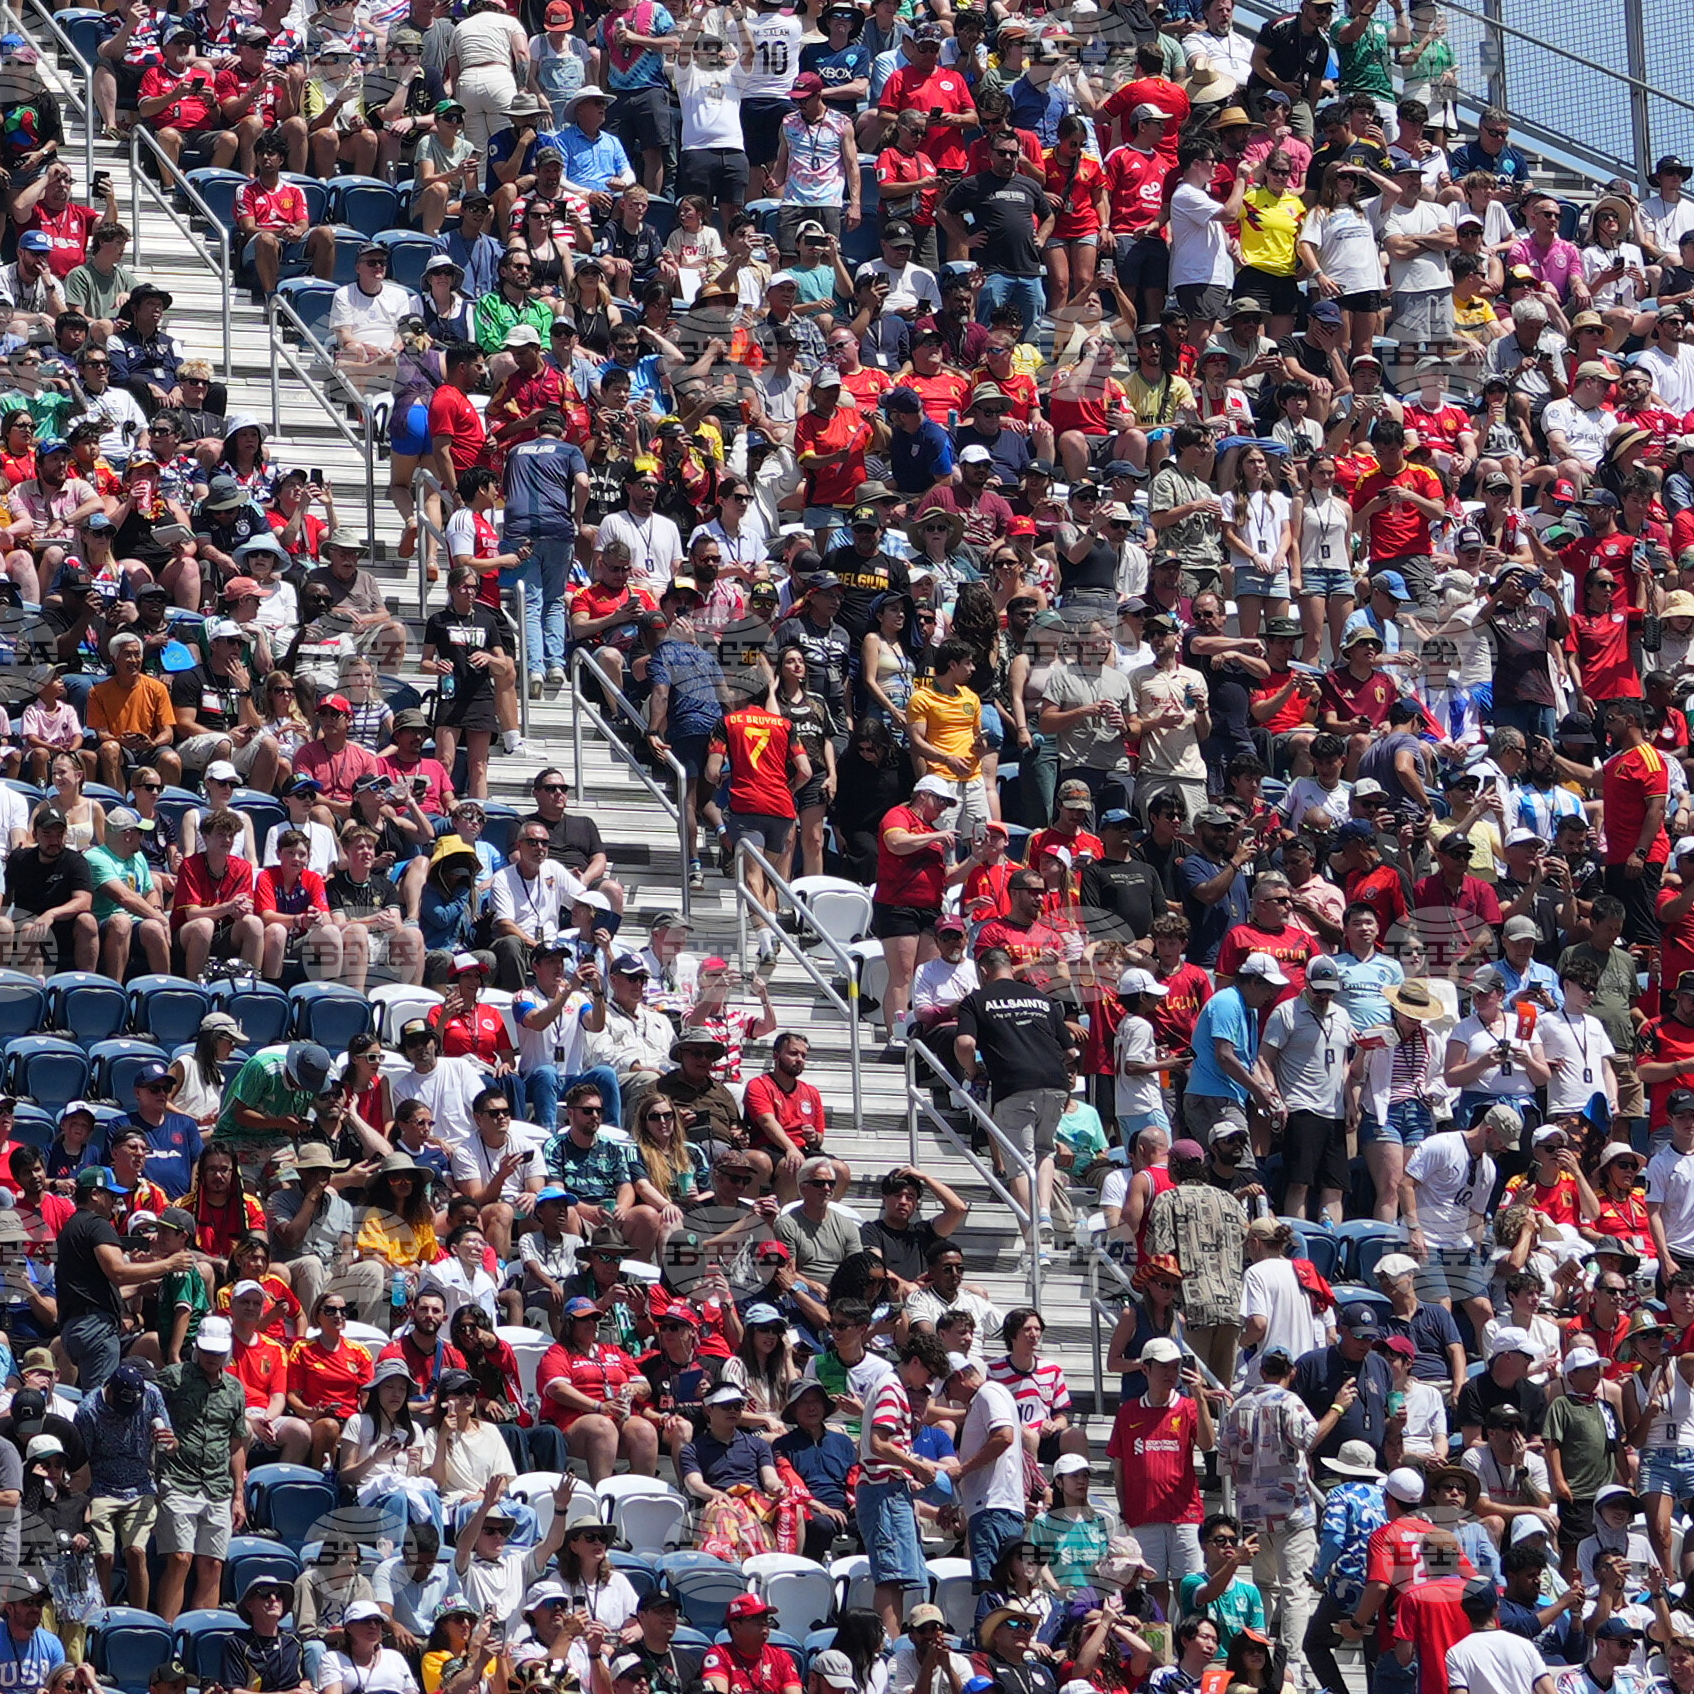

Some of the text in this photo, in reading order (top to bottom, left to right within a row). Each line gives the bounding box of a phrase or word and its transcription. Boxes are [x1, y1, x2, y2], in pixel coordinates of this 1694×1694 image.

[755, 40, 789, 76] 10
[817, 66, 854, 81] XBOX
[837, 572, 890, 591] BELGIUM
[729, 716, 743, 727] DE
[743, 726, 771, 771] 7
[984, 996, 1052, 1015] ALLSAINTS
